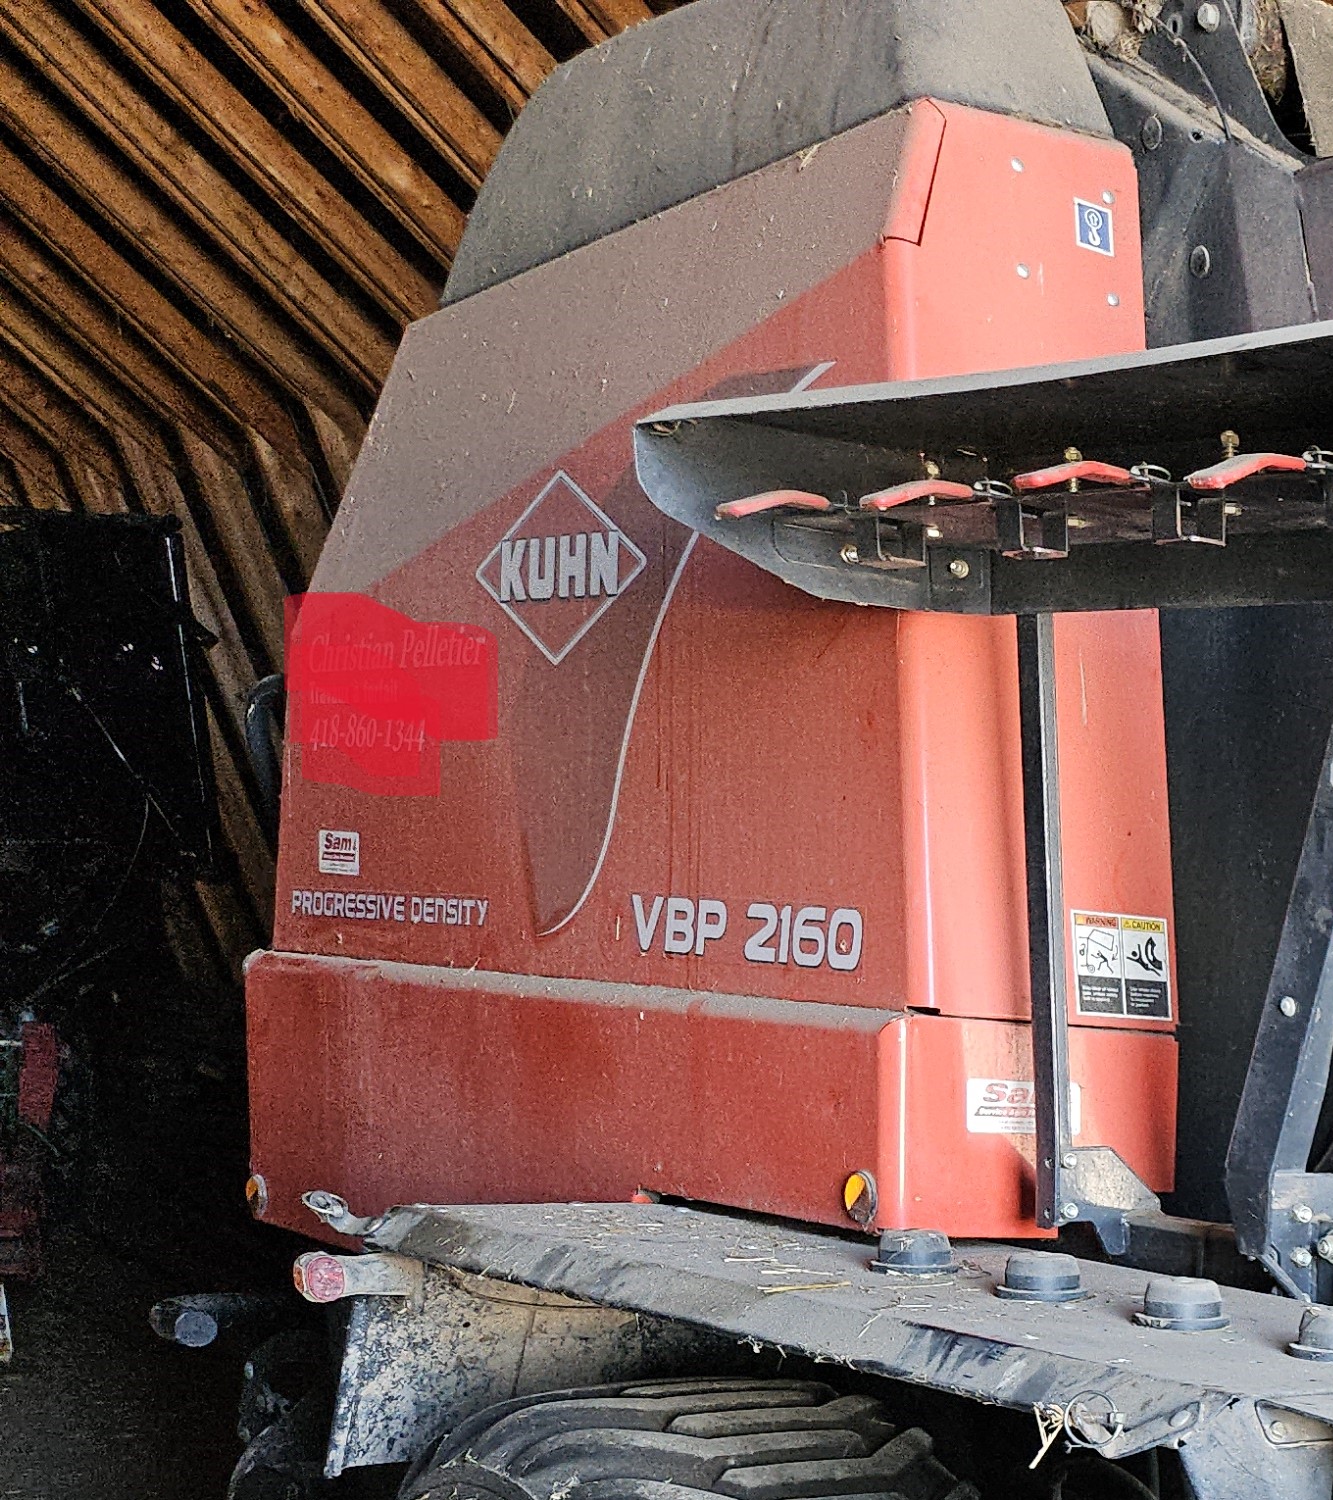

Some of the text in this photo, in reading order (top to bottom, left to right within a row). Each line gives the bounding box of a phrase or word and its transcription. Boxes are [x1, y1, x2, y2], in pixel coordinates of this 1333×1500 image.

[500, 530, 619, 602] KUHN
[291, 890, 488, 926] PROGRESSIVE DENSITY
[1132, 921, 1161, 931] CAUTION
[631, 893, 863, 971] VBP 2160
[983, 1082, 1036, 1104] Sa
